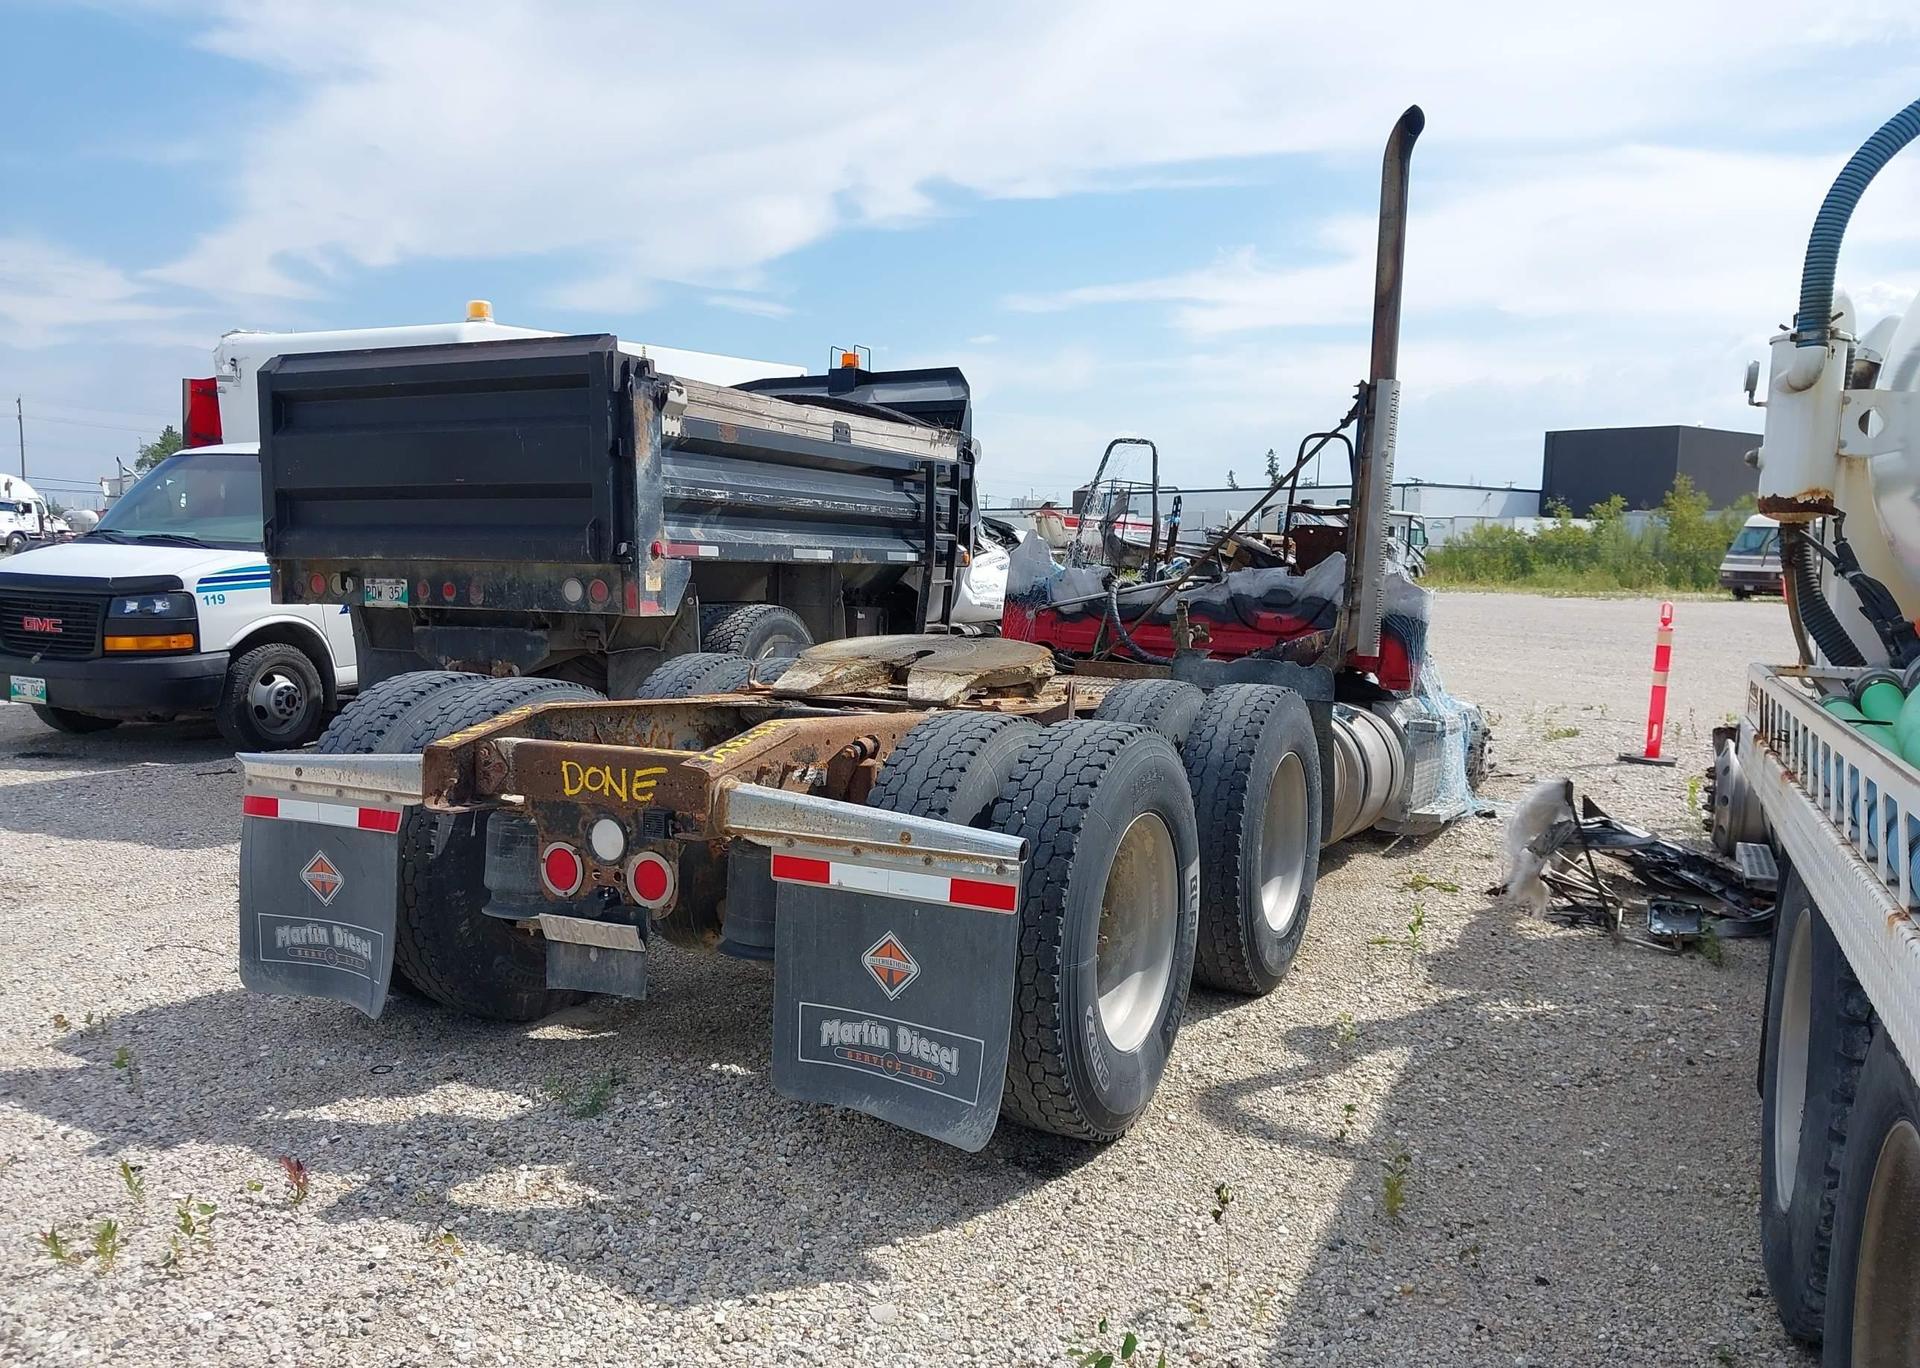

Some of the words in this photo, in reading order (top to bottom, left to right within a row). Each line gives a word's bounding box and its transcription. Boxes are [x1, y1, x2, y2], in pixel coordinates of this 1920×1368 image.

[202, 594, 226, 606] 119
[22, 616, 63, 633] GMC
[560, 759, 669, 802] DONE
[274, 922, 330, 949] Martin
[332, 924, 373, 962] Diesel
[868, 956, 912, 971] INTERNATIONAL
[820, 1018, 891, 1049] Martin
[897, 1025, 960, 1076] Diesel
[847, 1050, 902, 1071] SERVICE
[910, 1066, 937, 1081] LTD.
